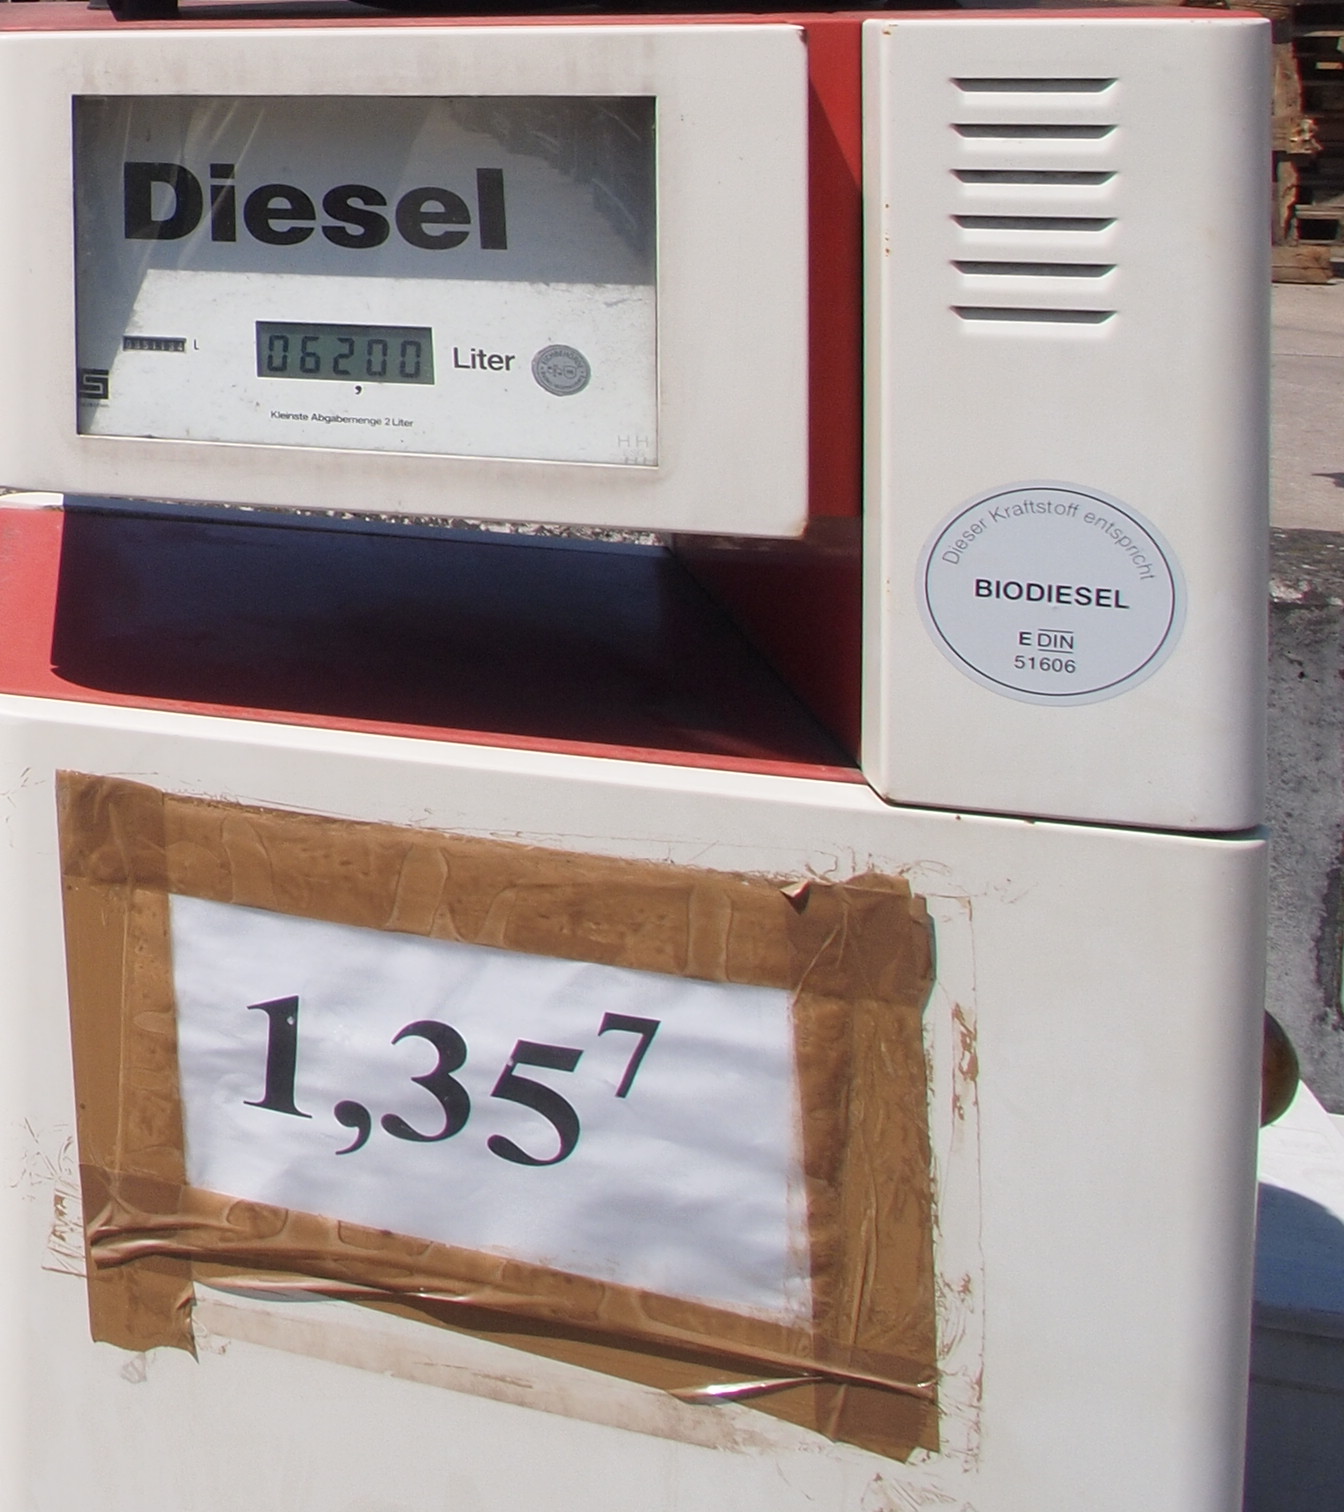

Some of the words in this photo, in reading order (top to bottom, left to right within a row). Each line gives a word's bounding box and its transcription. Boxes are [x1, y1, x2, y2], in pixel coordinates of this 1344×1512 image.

[123, 161, 509, 251] Diesel
[266, 334, 423, 379] 06200
[453, 346, 516, 371] Liter
[270, 410, 310, 421] Kleinste
[311, 412, 382, 427] Abgabemenge
[384, 417, 391, 426] 2
[392, 417, 415, 428] Liter
[942, 517, 989, 566] Dieser
[987, 499, 1081, 524] Kraftstoff
[1083, 510, 1156, 582] entspricht
[974, 578, 1131, 610] BIODIESEL
[1018, 630, 1033, 646] E
[1037, 632, 1074, 650] DIN
[1014, 654, 1077, 674] 51606
